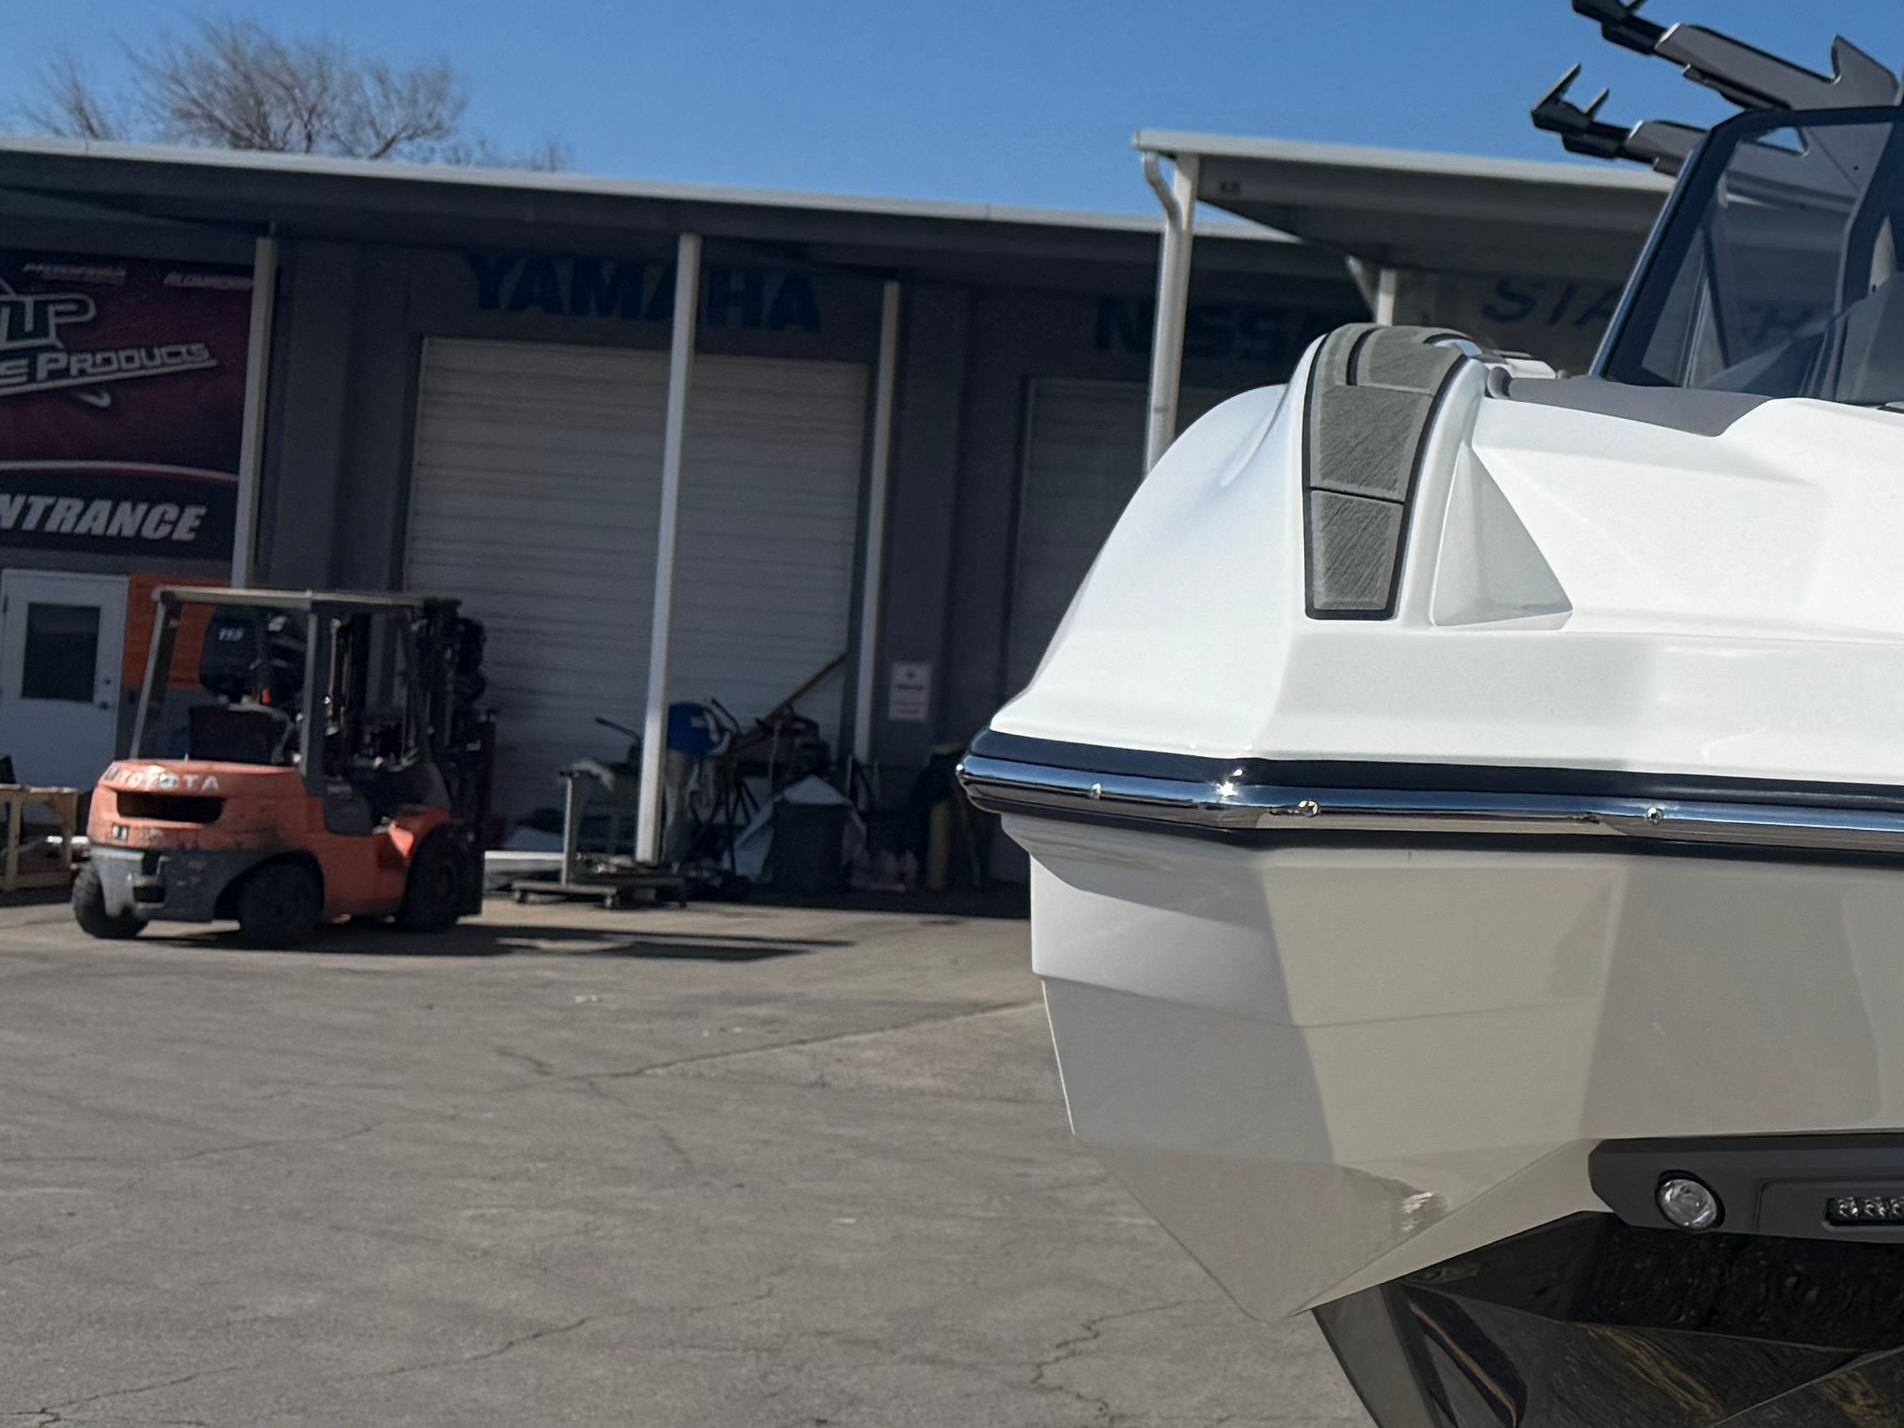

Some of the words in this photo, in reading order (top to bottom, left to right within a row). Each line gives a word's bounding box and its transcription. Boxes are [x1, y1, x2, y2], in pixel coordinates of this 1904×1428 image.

[35, 342, 212, 383] PRODUCTS
[0, 492, 208, 543] NTRANCE
[122, 768, 219, 791] TOYOTA
